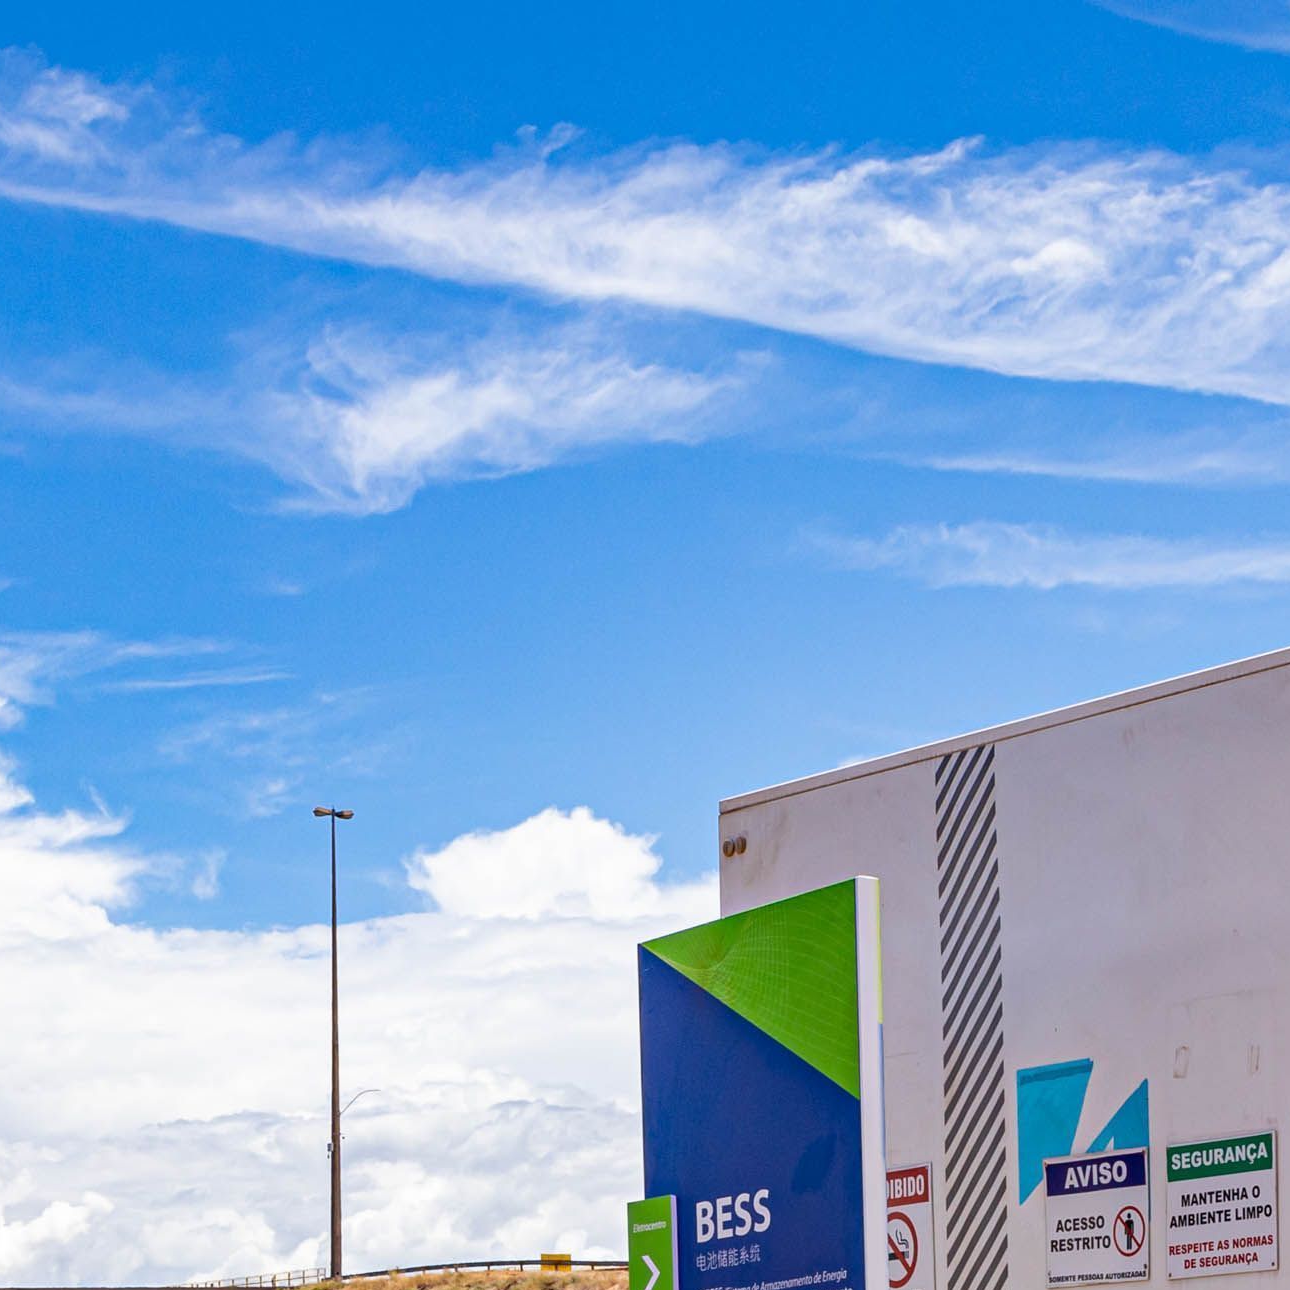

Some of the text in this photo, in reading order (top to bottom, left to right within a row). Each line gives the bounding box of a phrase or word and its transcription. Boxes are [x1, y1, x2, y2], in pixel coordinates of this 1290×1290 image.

[1171, 1142, 1268, 1170] SEGURANÇA
[1064, 1160, 1127, 1189] AVISO
[887, 1175, 925, 1199] IBIDO
[1181, 1185, 1260, 1207] MANTENHA O
[696, 1189, 771, 1243] BESS
[1056, 1216, 1105, 1232] ACESSO
[1169, 1204, 1272, 1228] AMBIENTE LIMPO
[1050, 1236, 1111, 1252] RESTRITO
[1169, 1235, 1273, 1256] RESPEITE AS NORMAS
[696, 1244, 761, 1272] 电池储能系统
[1184, 1252, 1258, 1269] DE SEGURANÇA
[813, 1272, 821, 1284] de
[822, 1270, 847, 1283] Energia
[1049, 1270, 1146, 1283] SOMENTE PESSOAS AUTORIZADAS
